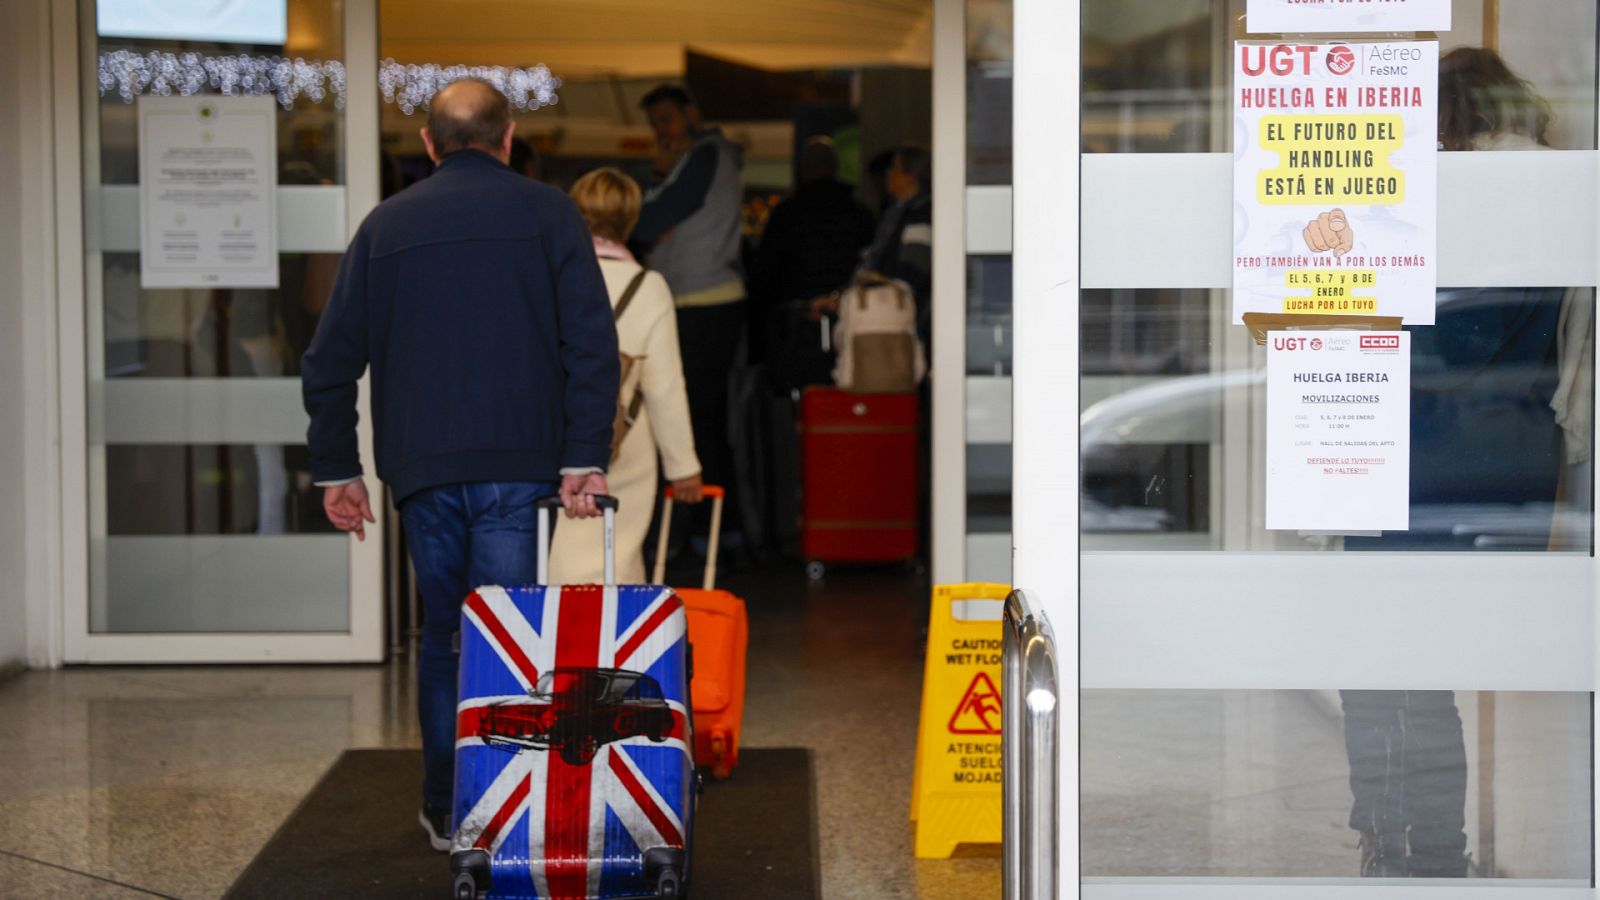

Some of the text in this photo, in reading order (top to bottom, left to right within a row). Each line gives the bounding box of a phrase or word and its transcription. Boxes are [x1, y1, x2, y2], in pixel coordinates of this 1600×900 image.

[1369, 44, 1421, 62] Aéreo
[1241, 46, 1318, 77] UGT
[1370, 66, 1408, 76] FeSMC
[1241, 87, 1422, 108] HUELGA EN IBERIA
[1267, 122, 1395, 141] EL FUTURO DEL
[1289, 150, 1374, 168] HANDLING
[1265, 174, 1397, 195] ESTÁ EN JUEGO
[1237, 254, 1425, 267] PERO TAMBIÉN VAN A POR LOS DEMÁS
[1289, 273, 1298, 283] EL
[1328, 273, 1334, 283] 7
[1352, 273, 1359, 283] 8
[1362, 273, 1373, 283] DE
[1317, 287, 1344, 297] ENERO
[1286, 300, 1374, 310] LUCHA POR LO TUYO
[1274, 338, 1307, 351] UGT
[1361, 337, 1398, 347] CCOO
[1293, 373, 1389, 383] HUELGA IBERIA
[1302, 395, 1380, 403] MOVILIZACIONES
[952, 639, 1002, 649] CAUTIO
[946, 654, 1002, 665] WET FLO
[948, 743, 1002, 754] ATENCI
[954, 772, 1002, 783] MOJAD
